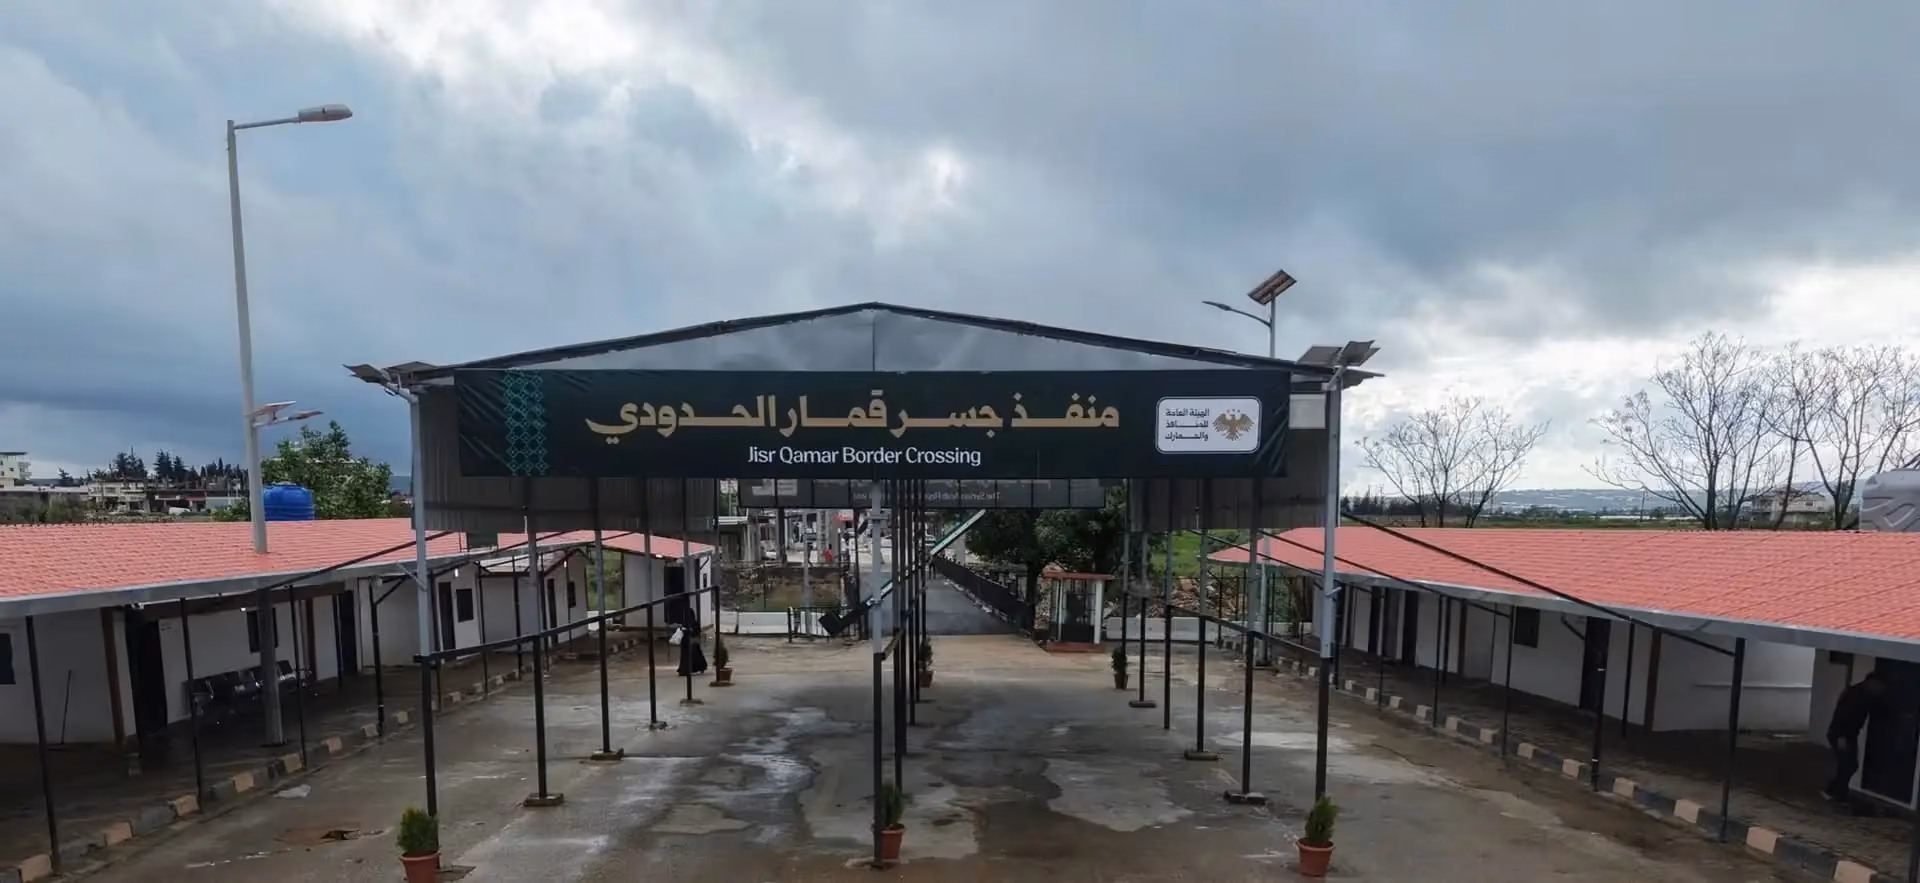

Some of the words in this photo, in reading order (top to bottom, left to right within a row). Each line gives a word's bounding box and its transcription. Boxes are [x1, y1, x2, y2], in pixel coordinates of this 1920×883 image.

[585, 395, 777, 445] الحدودي
[779, 389, 887, 438] قمار
[890, 405, 1003, 438] جسر
[1011, 392, 1119, 427] منفذ
[1165, 408, 1189, 417] العامة
[747, 446, 777, 463] Jisr
[779, 446, 839, 465] Qamar
[842, 446, 903, 464] Border
[905, 446, 981, 467] Crossing
